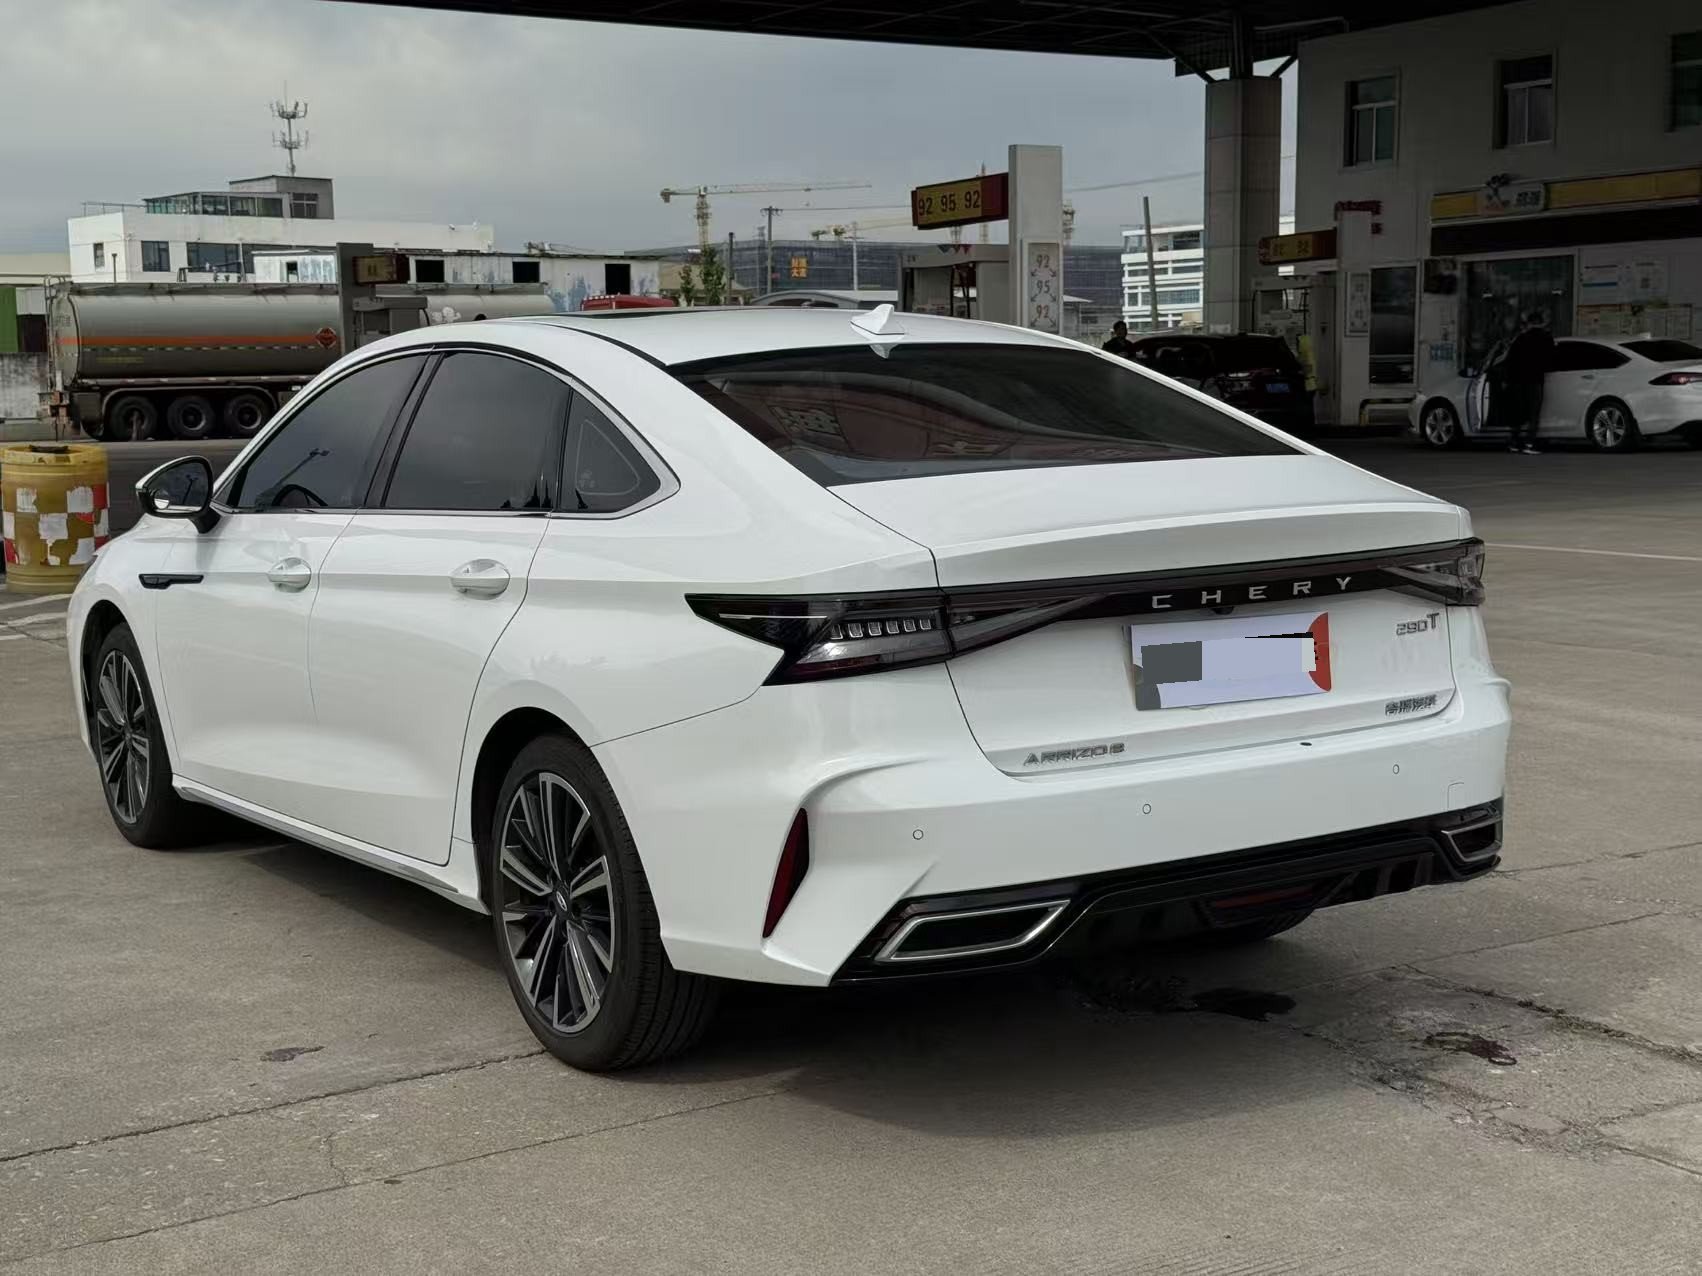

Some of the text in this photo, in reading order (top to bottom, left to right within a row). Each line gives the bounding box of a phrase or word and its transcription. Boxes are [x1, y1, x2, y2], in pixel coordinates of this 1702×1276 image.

[918, 190, 980, 216] 92 95 92
[1036, 254, 1050, 269] 92
[1036, 279, 1050, 294] 95
[1036, 304, 1049, 319] 92
[1152, 576, 1351, 609] CHERY
[1396, 612, 1440, 636] 290T
